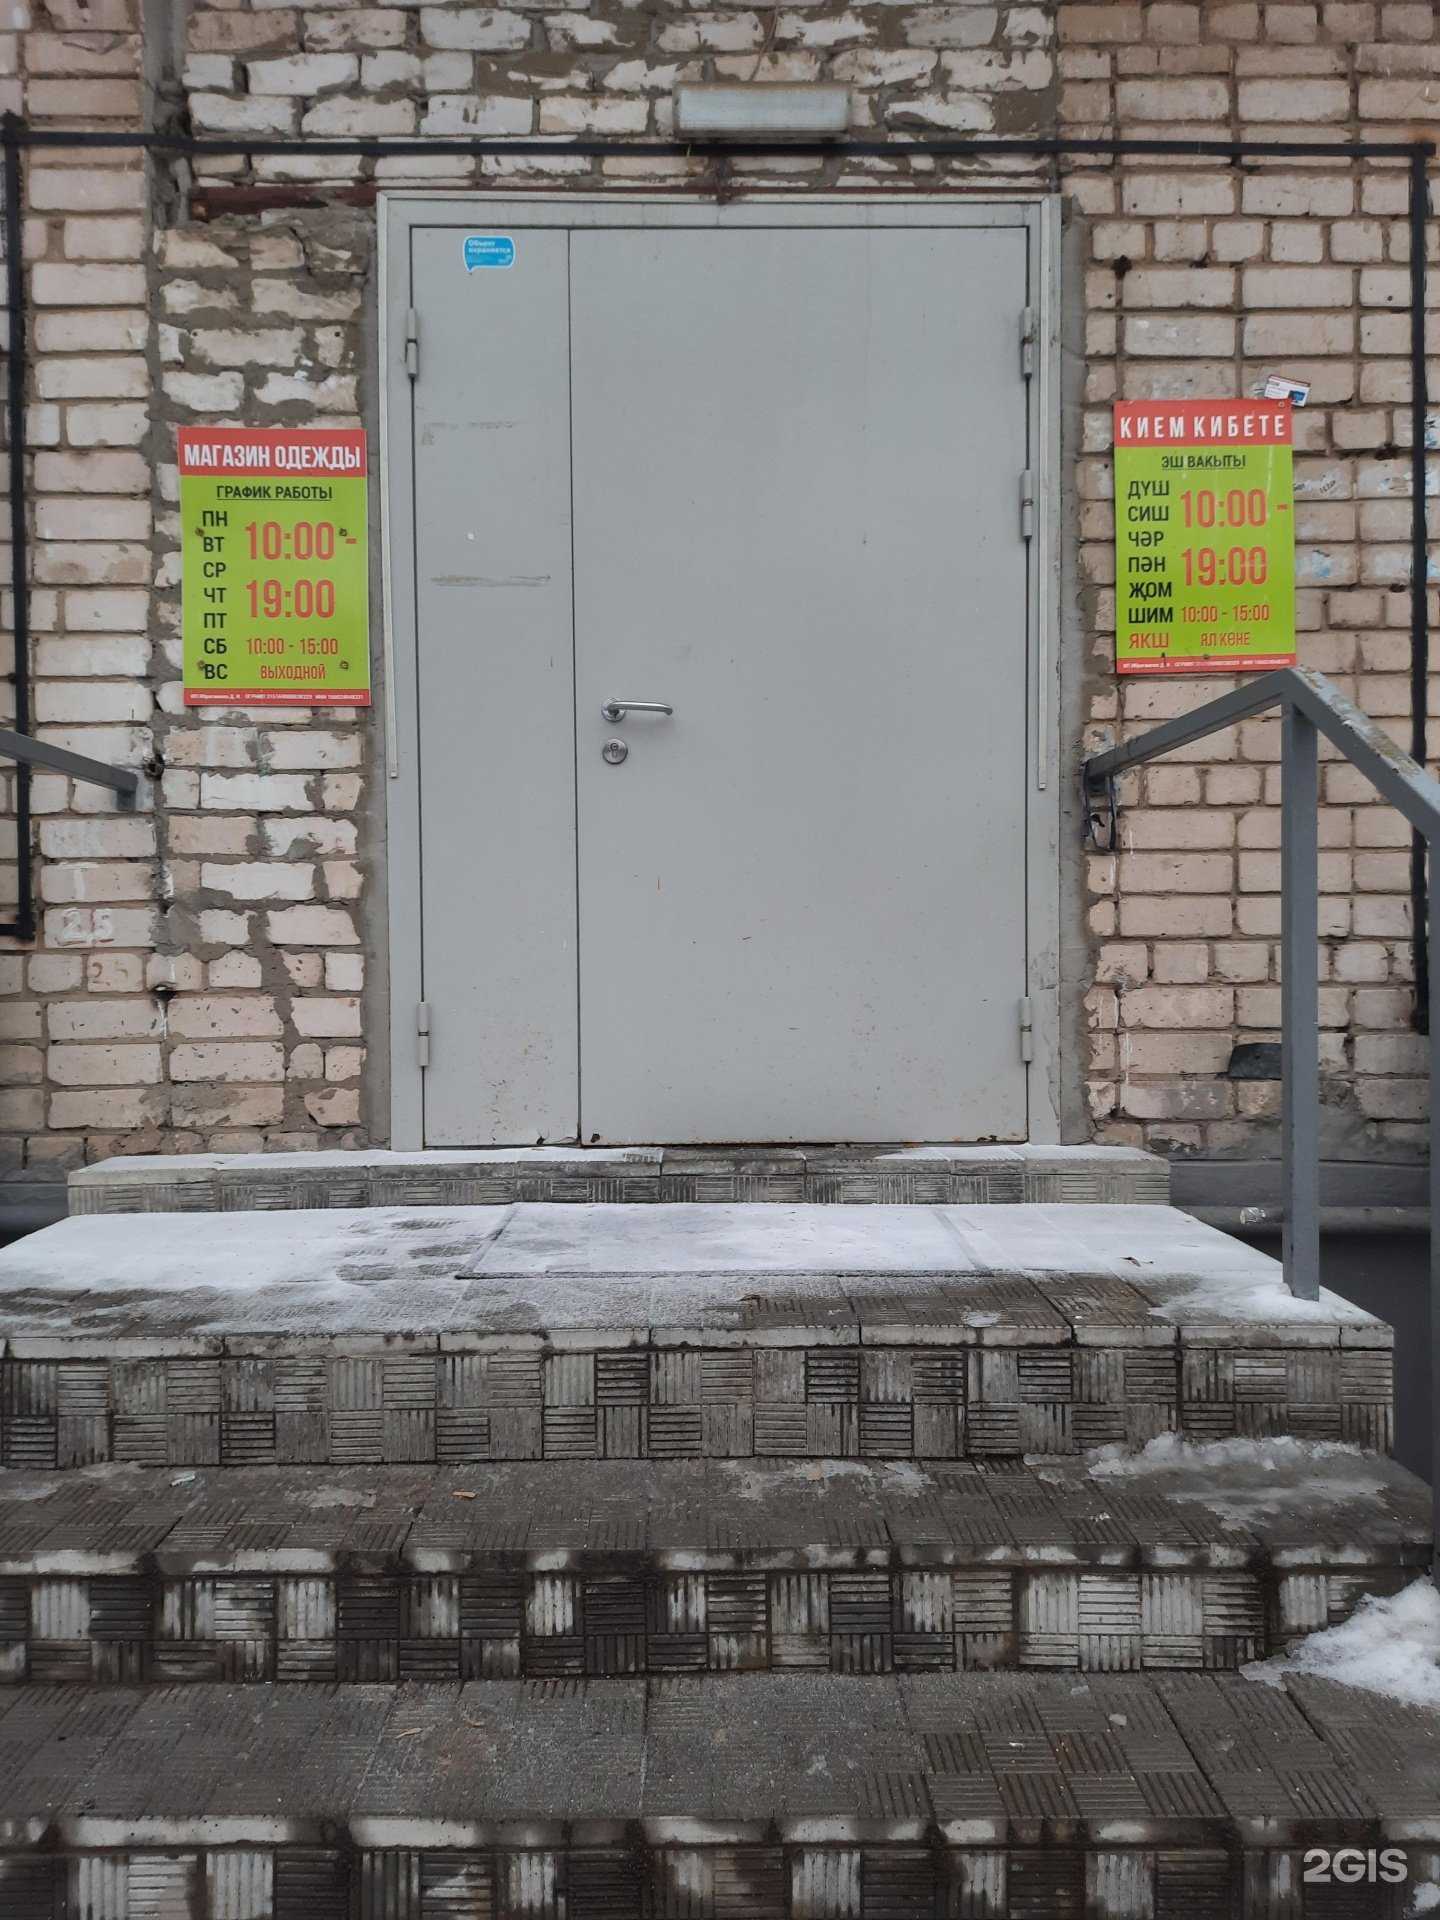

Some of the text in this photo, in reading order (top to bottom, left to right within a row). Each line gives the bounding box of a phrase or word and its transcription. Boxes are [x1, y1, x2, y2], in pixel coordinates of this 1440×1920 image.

[1120, 414, 1285, 439] КИЕМ КИБЕТЕ
[184, 444, 361, 470] МАГАЗИН ОДЕЖДЫ
[1161, 454, 1246, 468] ЭШ ВАКЫТЫ
[216, 485, 333, 500] ГРАФИК РАБОТЫ
[1128, 505, 1169, 522] СИШ
[1180, 489, 1267, 528] 10:00
[202, 510, 228, 527] ПН
[203, 537, 224, 553] ВТ
[245, 521, 335, 560] 10:00
[1128, 531, 1164, 547] ЧӘР
[203, 562, 226, 578] СР
[1128, 556, 1166, 573] ПӘН
[1181, 547, 1267, 586] 19:00
[204, 587, 226, 603] ЧТ
[246, 579, 335, 619] 19:00
[204, 613, 227, 628] ПТ
[1128, 607, 1173, 624] ШИМ
[1182, 606, 1218, 623] 10:00
[1233, 604, 1270, 621] 15:00
[204, 638, 227, 654] СБ
[246, 638, 284, 655] 10:00
[300, 638, 339, 655] 15:00
[1129, 633, 1169, 649] ЯКШ
[204, 662, 326, 681] ВС ВЫХОДНОЙ
